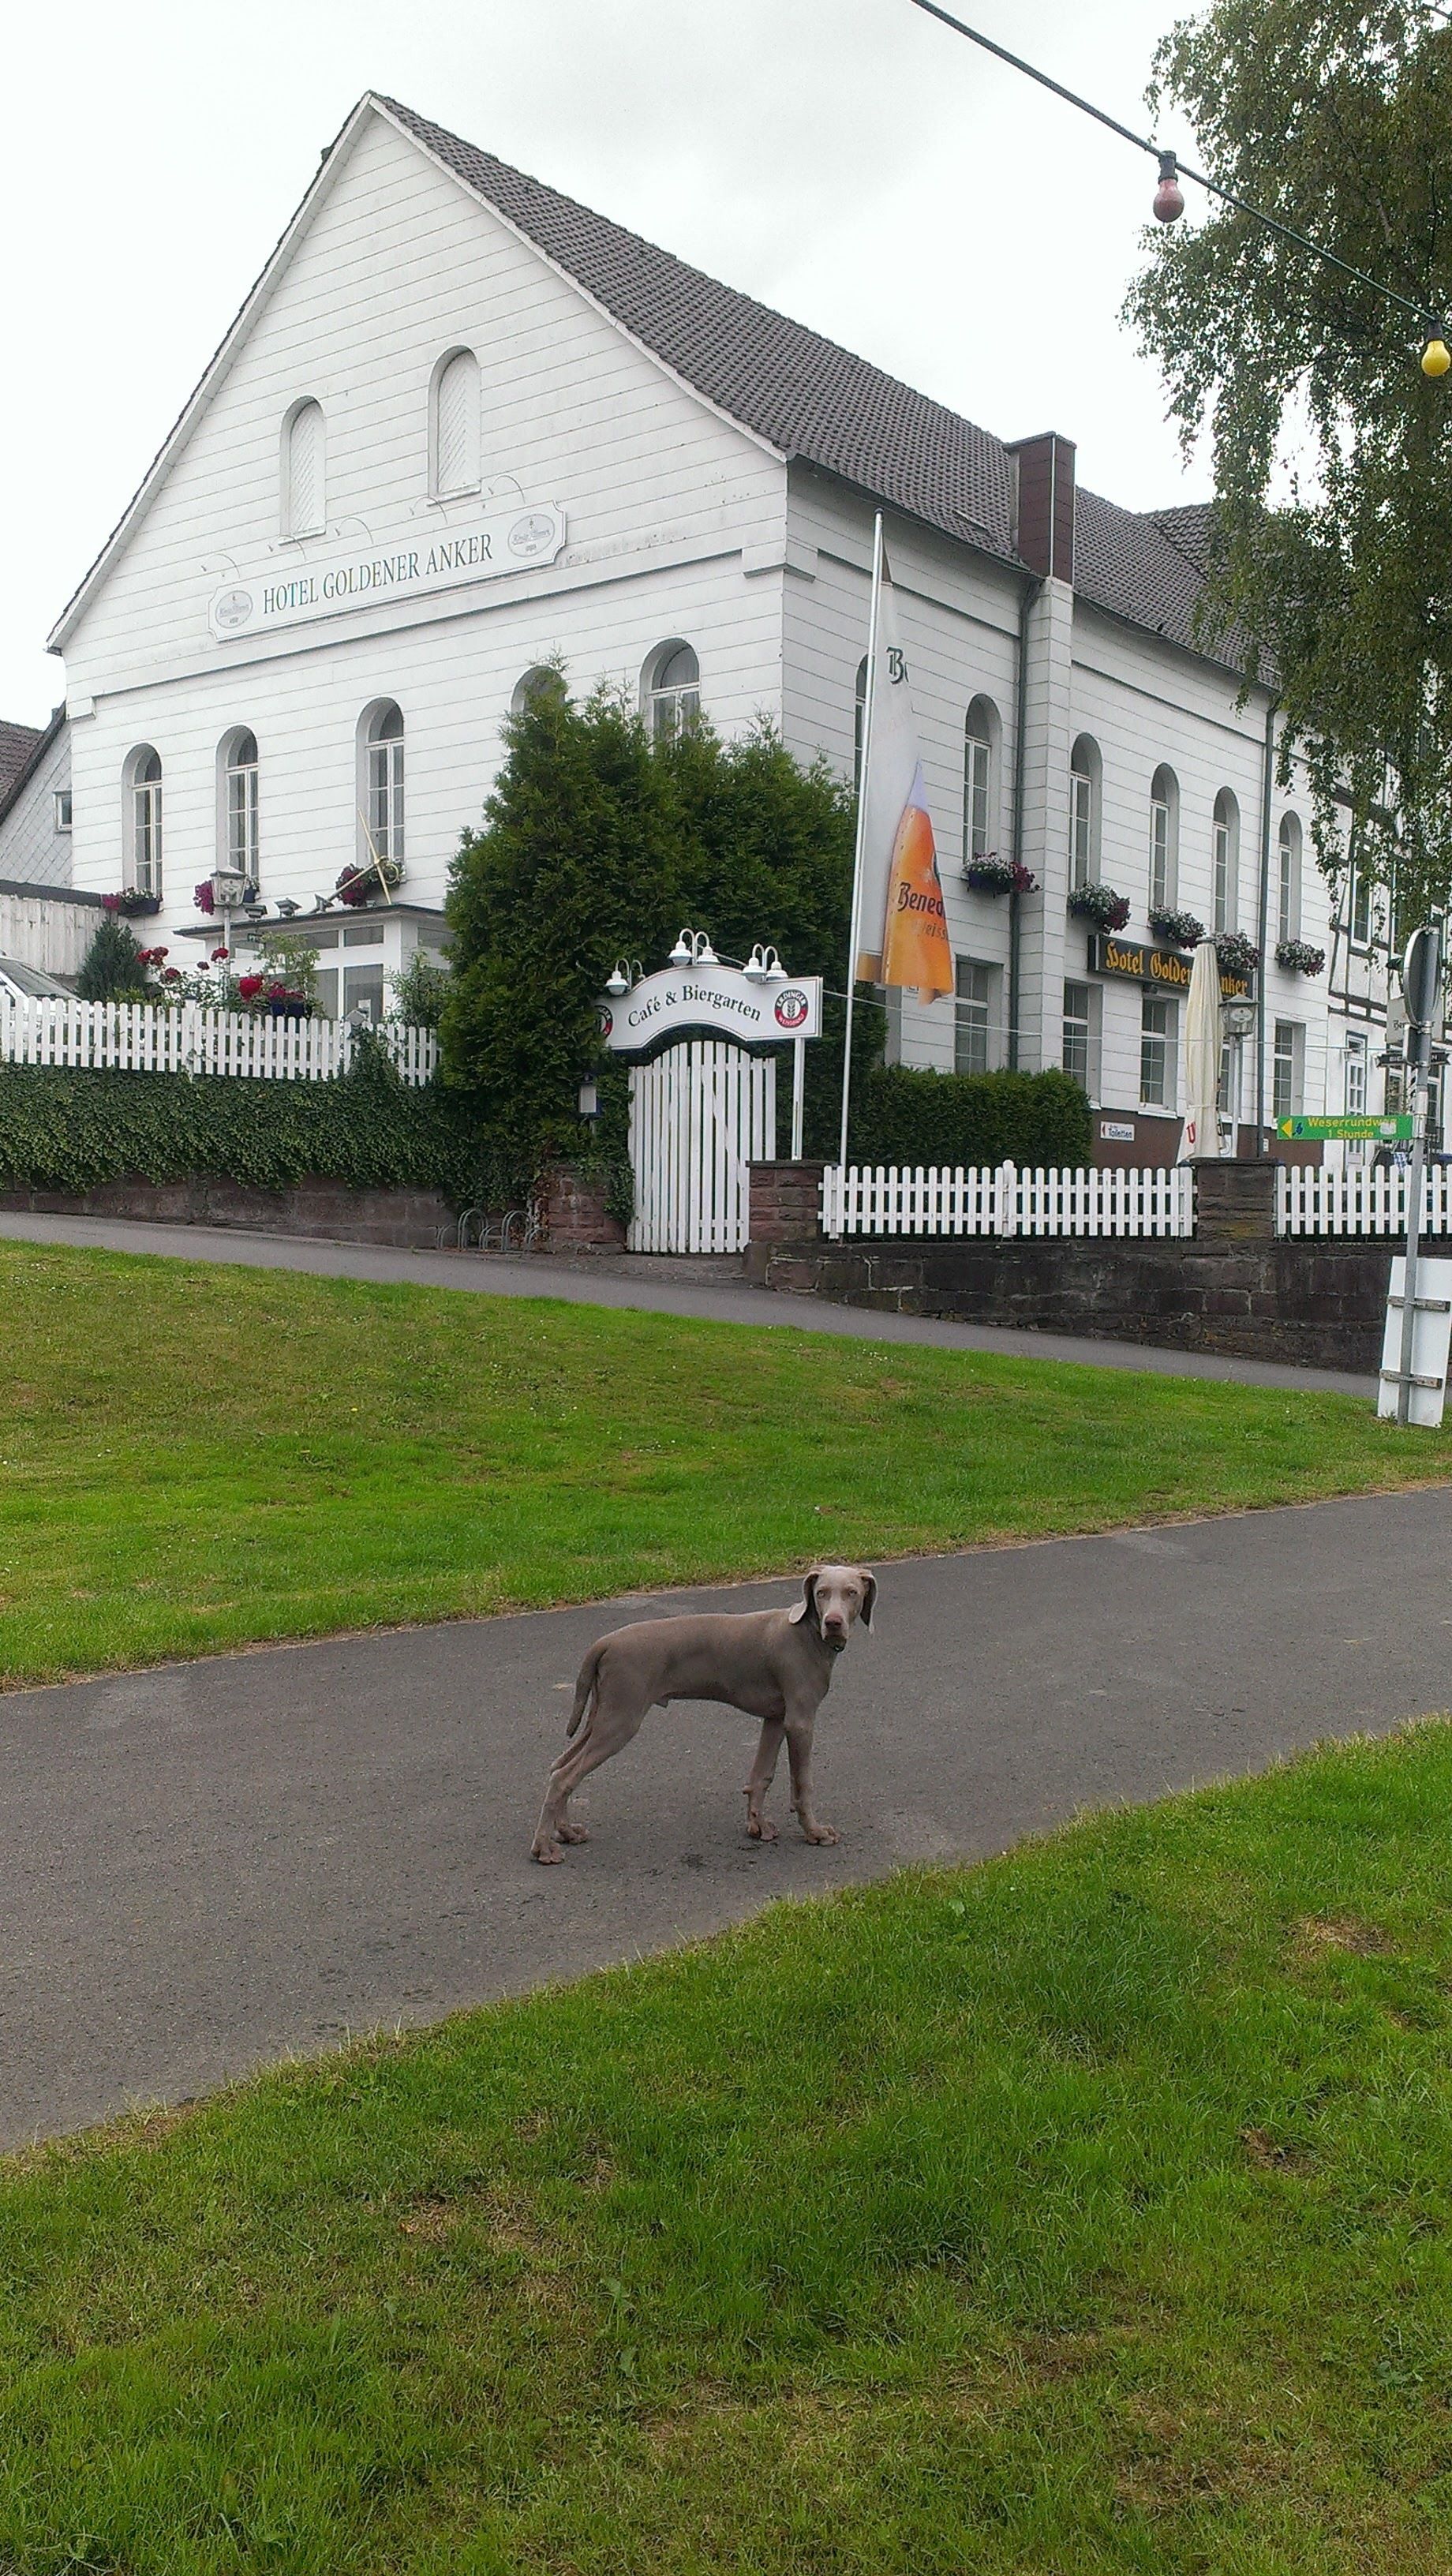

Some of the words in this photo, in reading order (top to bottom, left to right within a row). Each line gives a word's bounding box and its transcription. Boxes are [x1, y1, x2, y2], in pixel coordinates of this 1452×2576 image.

[263, 577, 319, 614] HOTEL
[323, 552, 420, 599] GOLDENER
[425, 534, 493, 575] ANKER
[1106, 940, 1144, 975] Hotel
[1221, 976, 1248, 995] nker
[628, 995, 662, 1028] Café
[665, 990, 678, 1006] &
[681, 984, 762, 1022] Biergarten
[1337, 1129, 1374, 1139] Stunde
